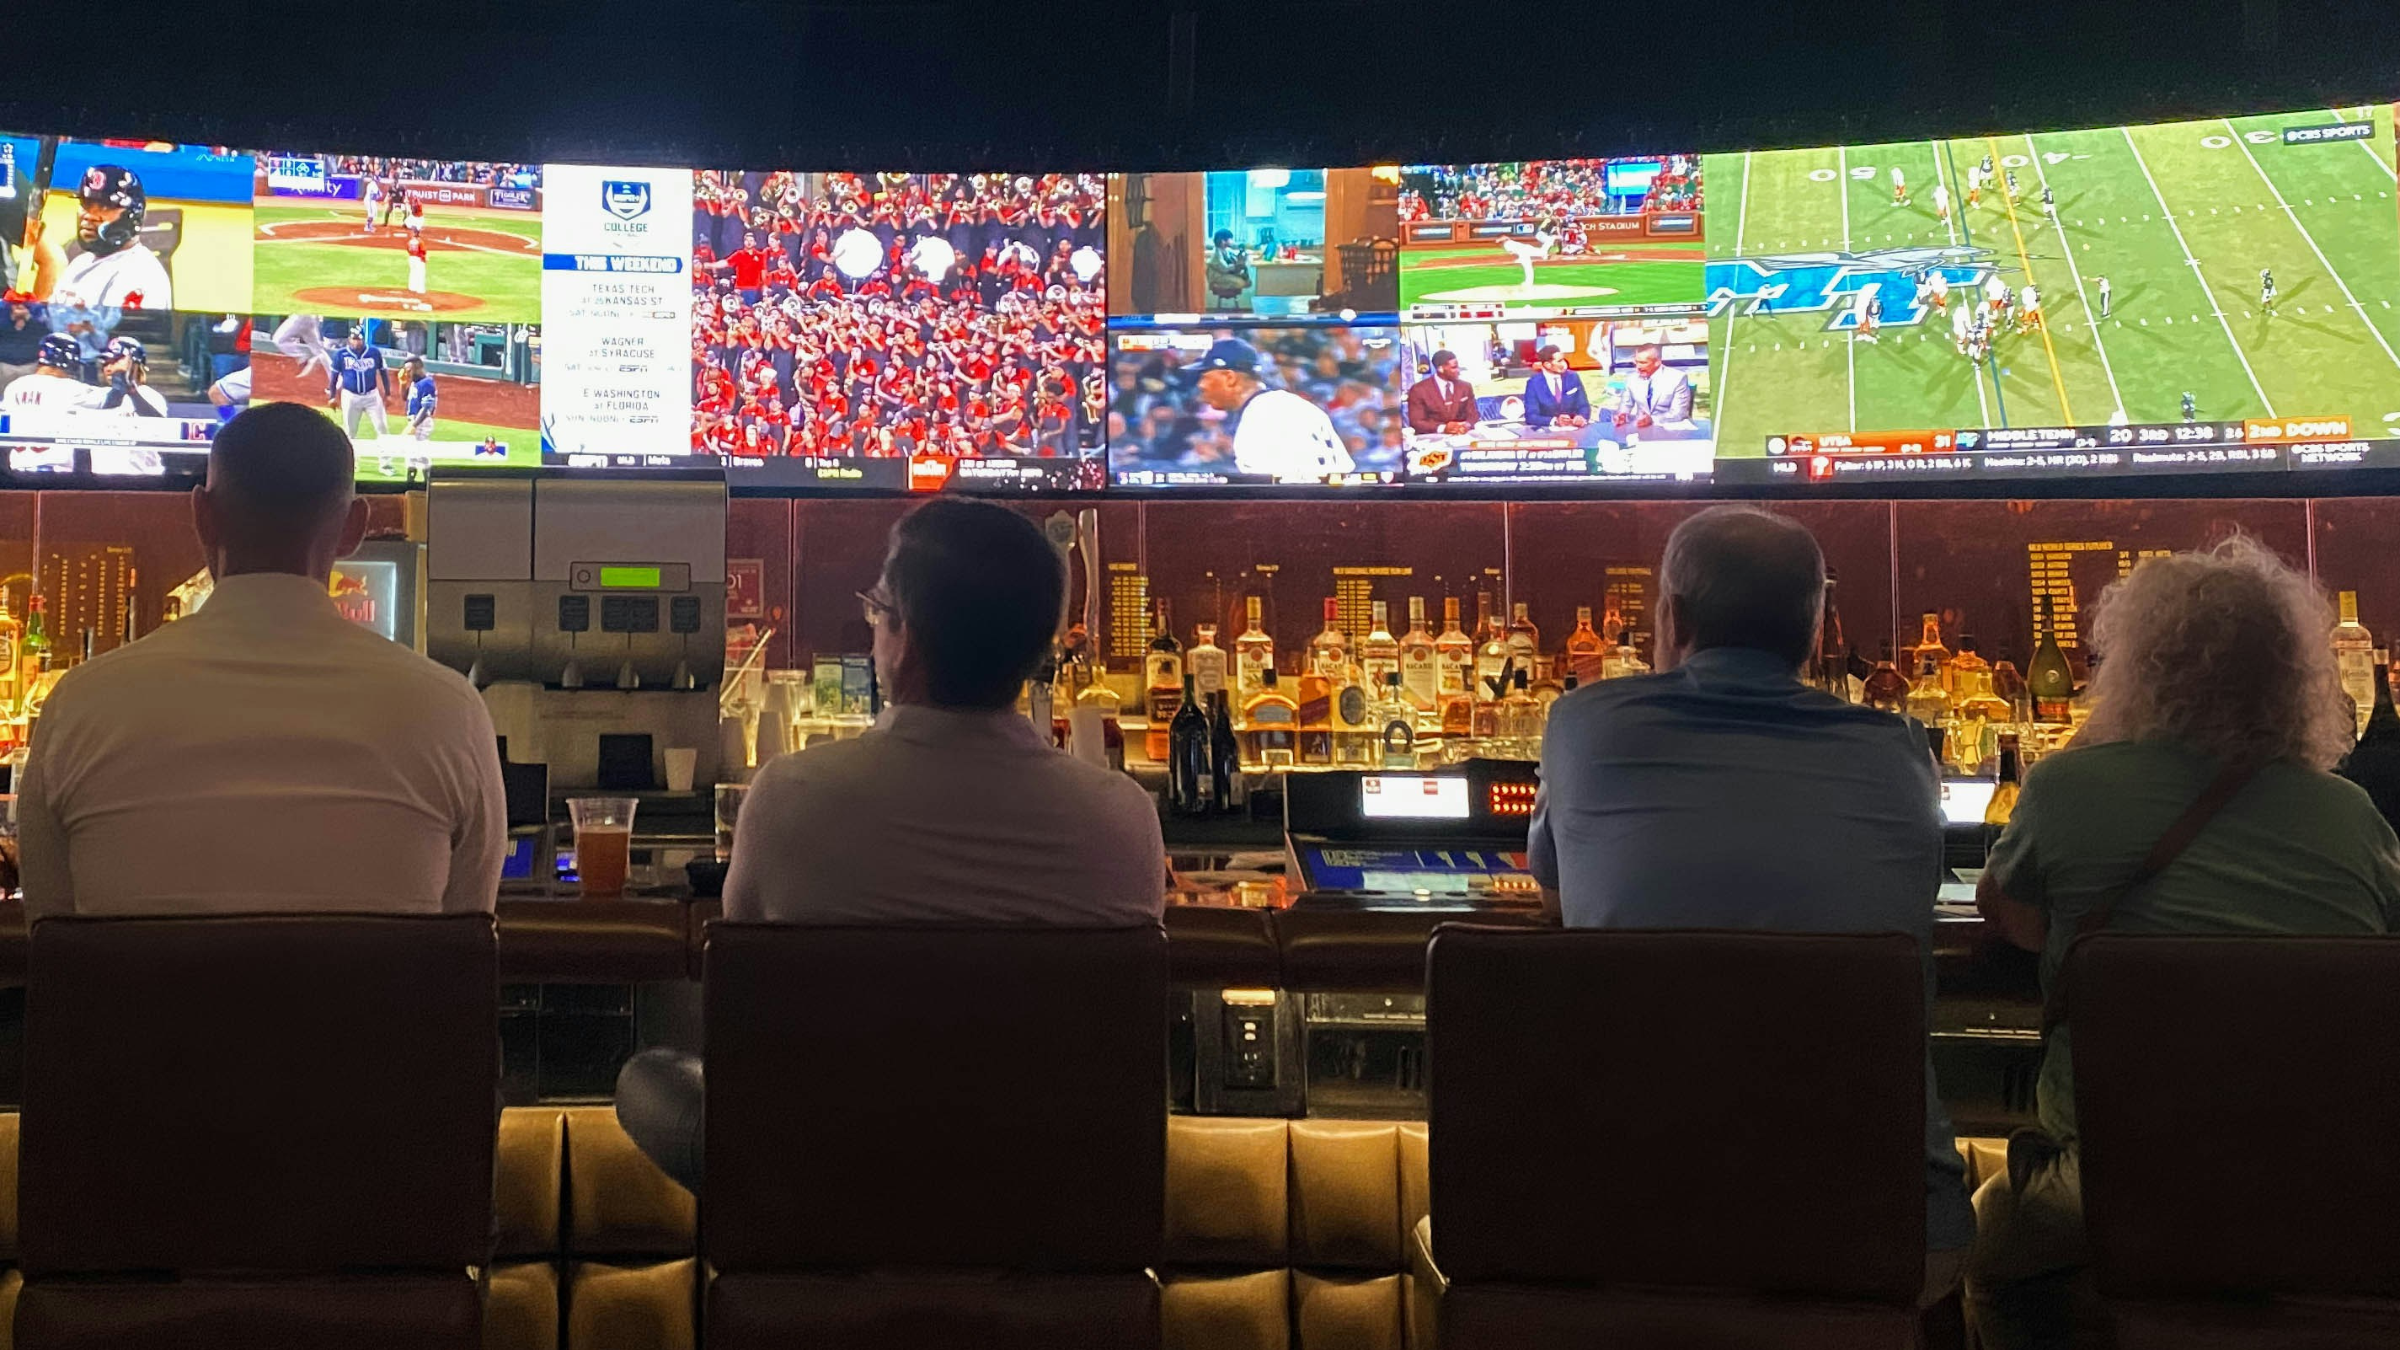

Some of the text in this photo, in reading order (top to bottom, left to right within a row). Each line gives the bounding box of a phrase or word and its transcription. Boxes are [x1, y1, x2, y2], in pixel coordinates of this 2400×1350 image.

[2323, 125, 2370, 137] SPORTS
[407, 189, 475, 201] TRUIST PARK
[604, 222, 648, 232] COLLEGE
[1599, 222, 1639, 231] STADIUM
[575, 255, 677, 272] THIS WEEKEND
[593, 284, 655, 294] TEXAS TECH
[605, 296, 647, 305] KANSAS
[650, 297, 662, 305] ST
[602, 337, 644, 346] WAGNER
[602, 348, 655, 359] SYRACUSE
[594, 389, 660, 399] WASHINGTON
[606, 401, 649, 411] FLORIDA
[1987, 430, 2037, 442] MIDDLE
[2038, 429, 2076, 440] TENN
[2109, 429, 2132, 443] 20
[2139, 428, 2169, 441] 3RD
[2248, 424, 2282, 438] 2ND
[2286, 421, 2347, 437] DOWN
[1819, 435, 1852, 447] UTSA
[1935, 434, 1951, 447] 31
[2325, 442, 2371, 453] SPORTS
[2301, 452, 2362, 463] NETWORK
